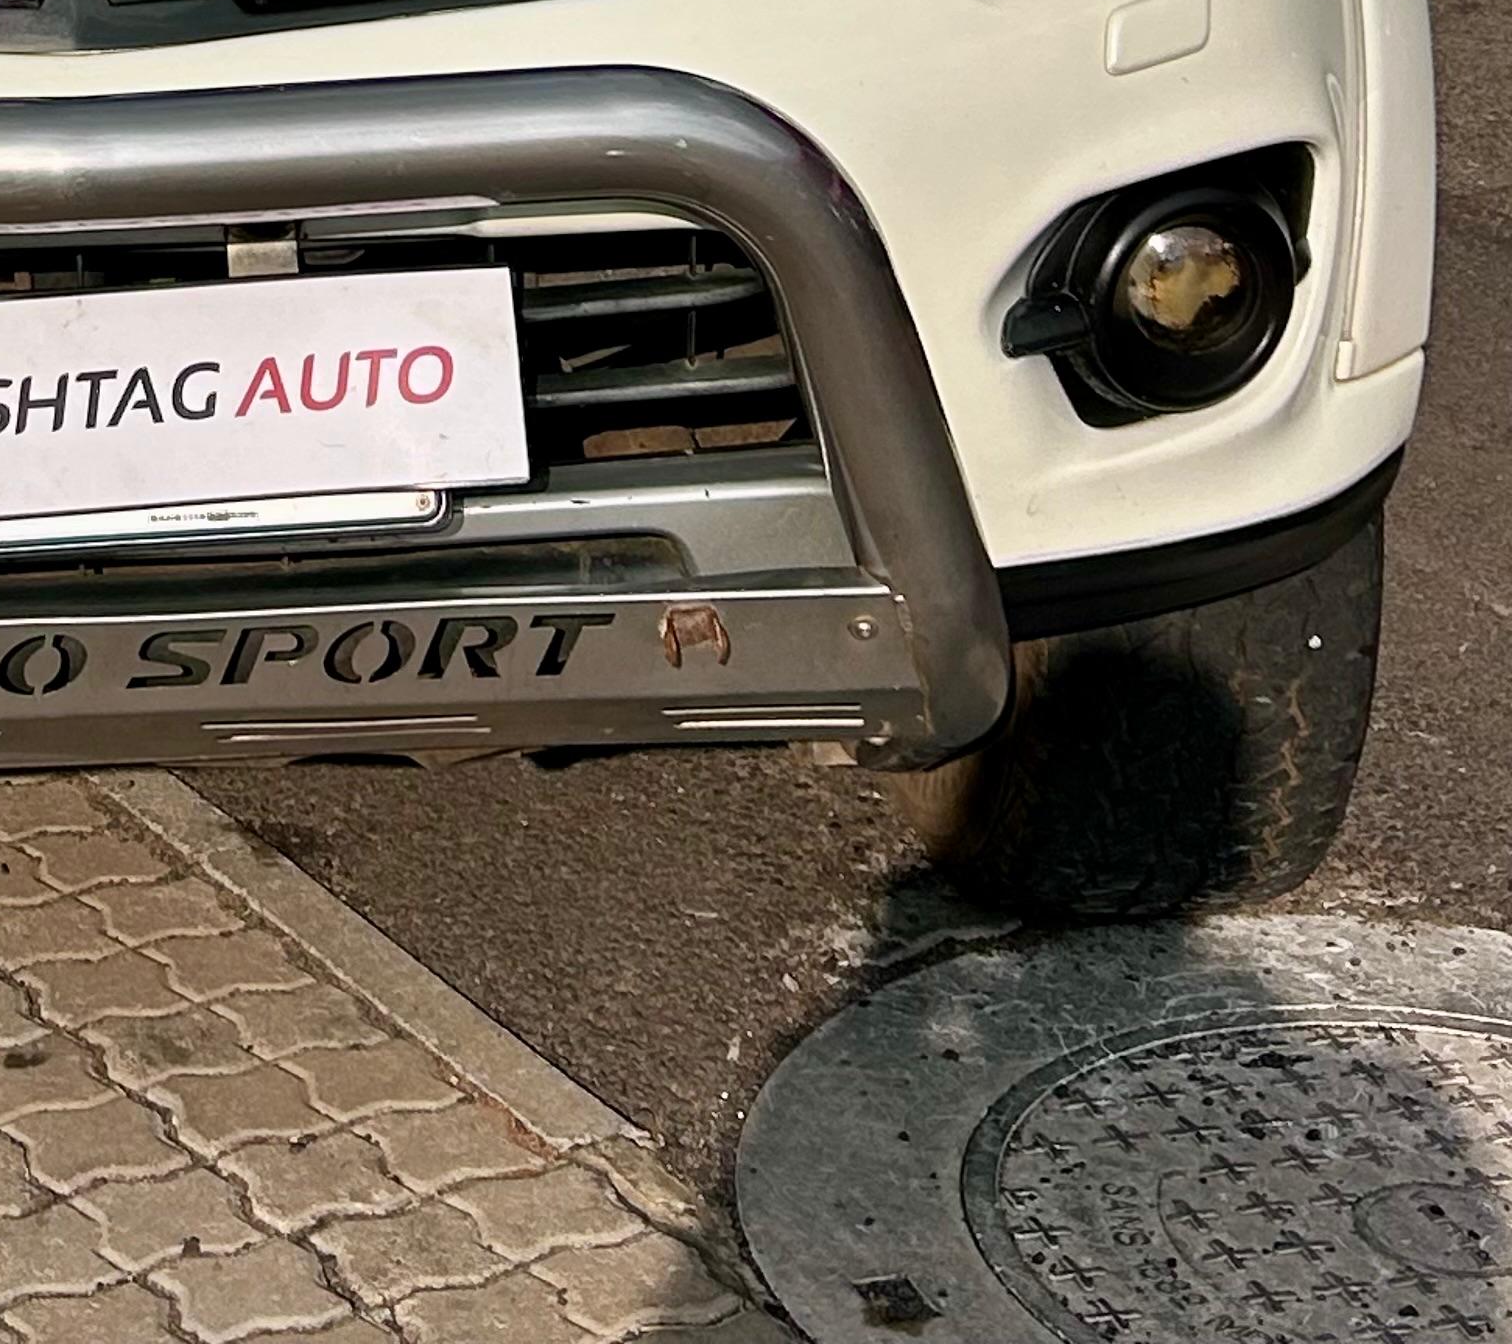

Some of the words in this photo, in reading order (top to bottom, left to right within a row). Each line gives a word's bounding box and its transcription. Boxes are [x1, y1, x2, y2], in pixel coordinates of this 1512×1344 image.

[235, 344, 455, 419] AUTO
[125, 612, 616, 690] SPORT
[1100, 1182, 1151, 1247] SANS
